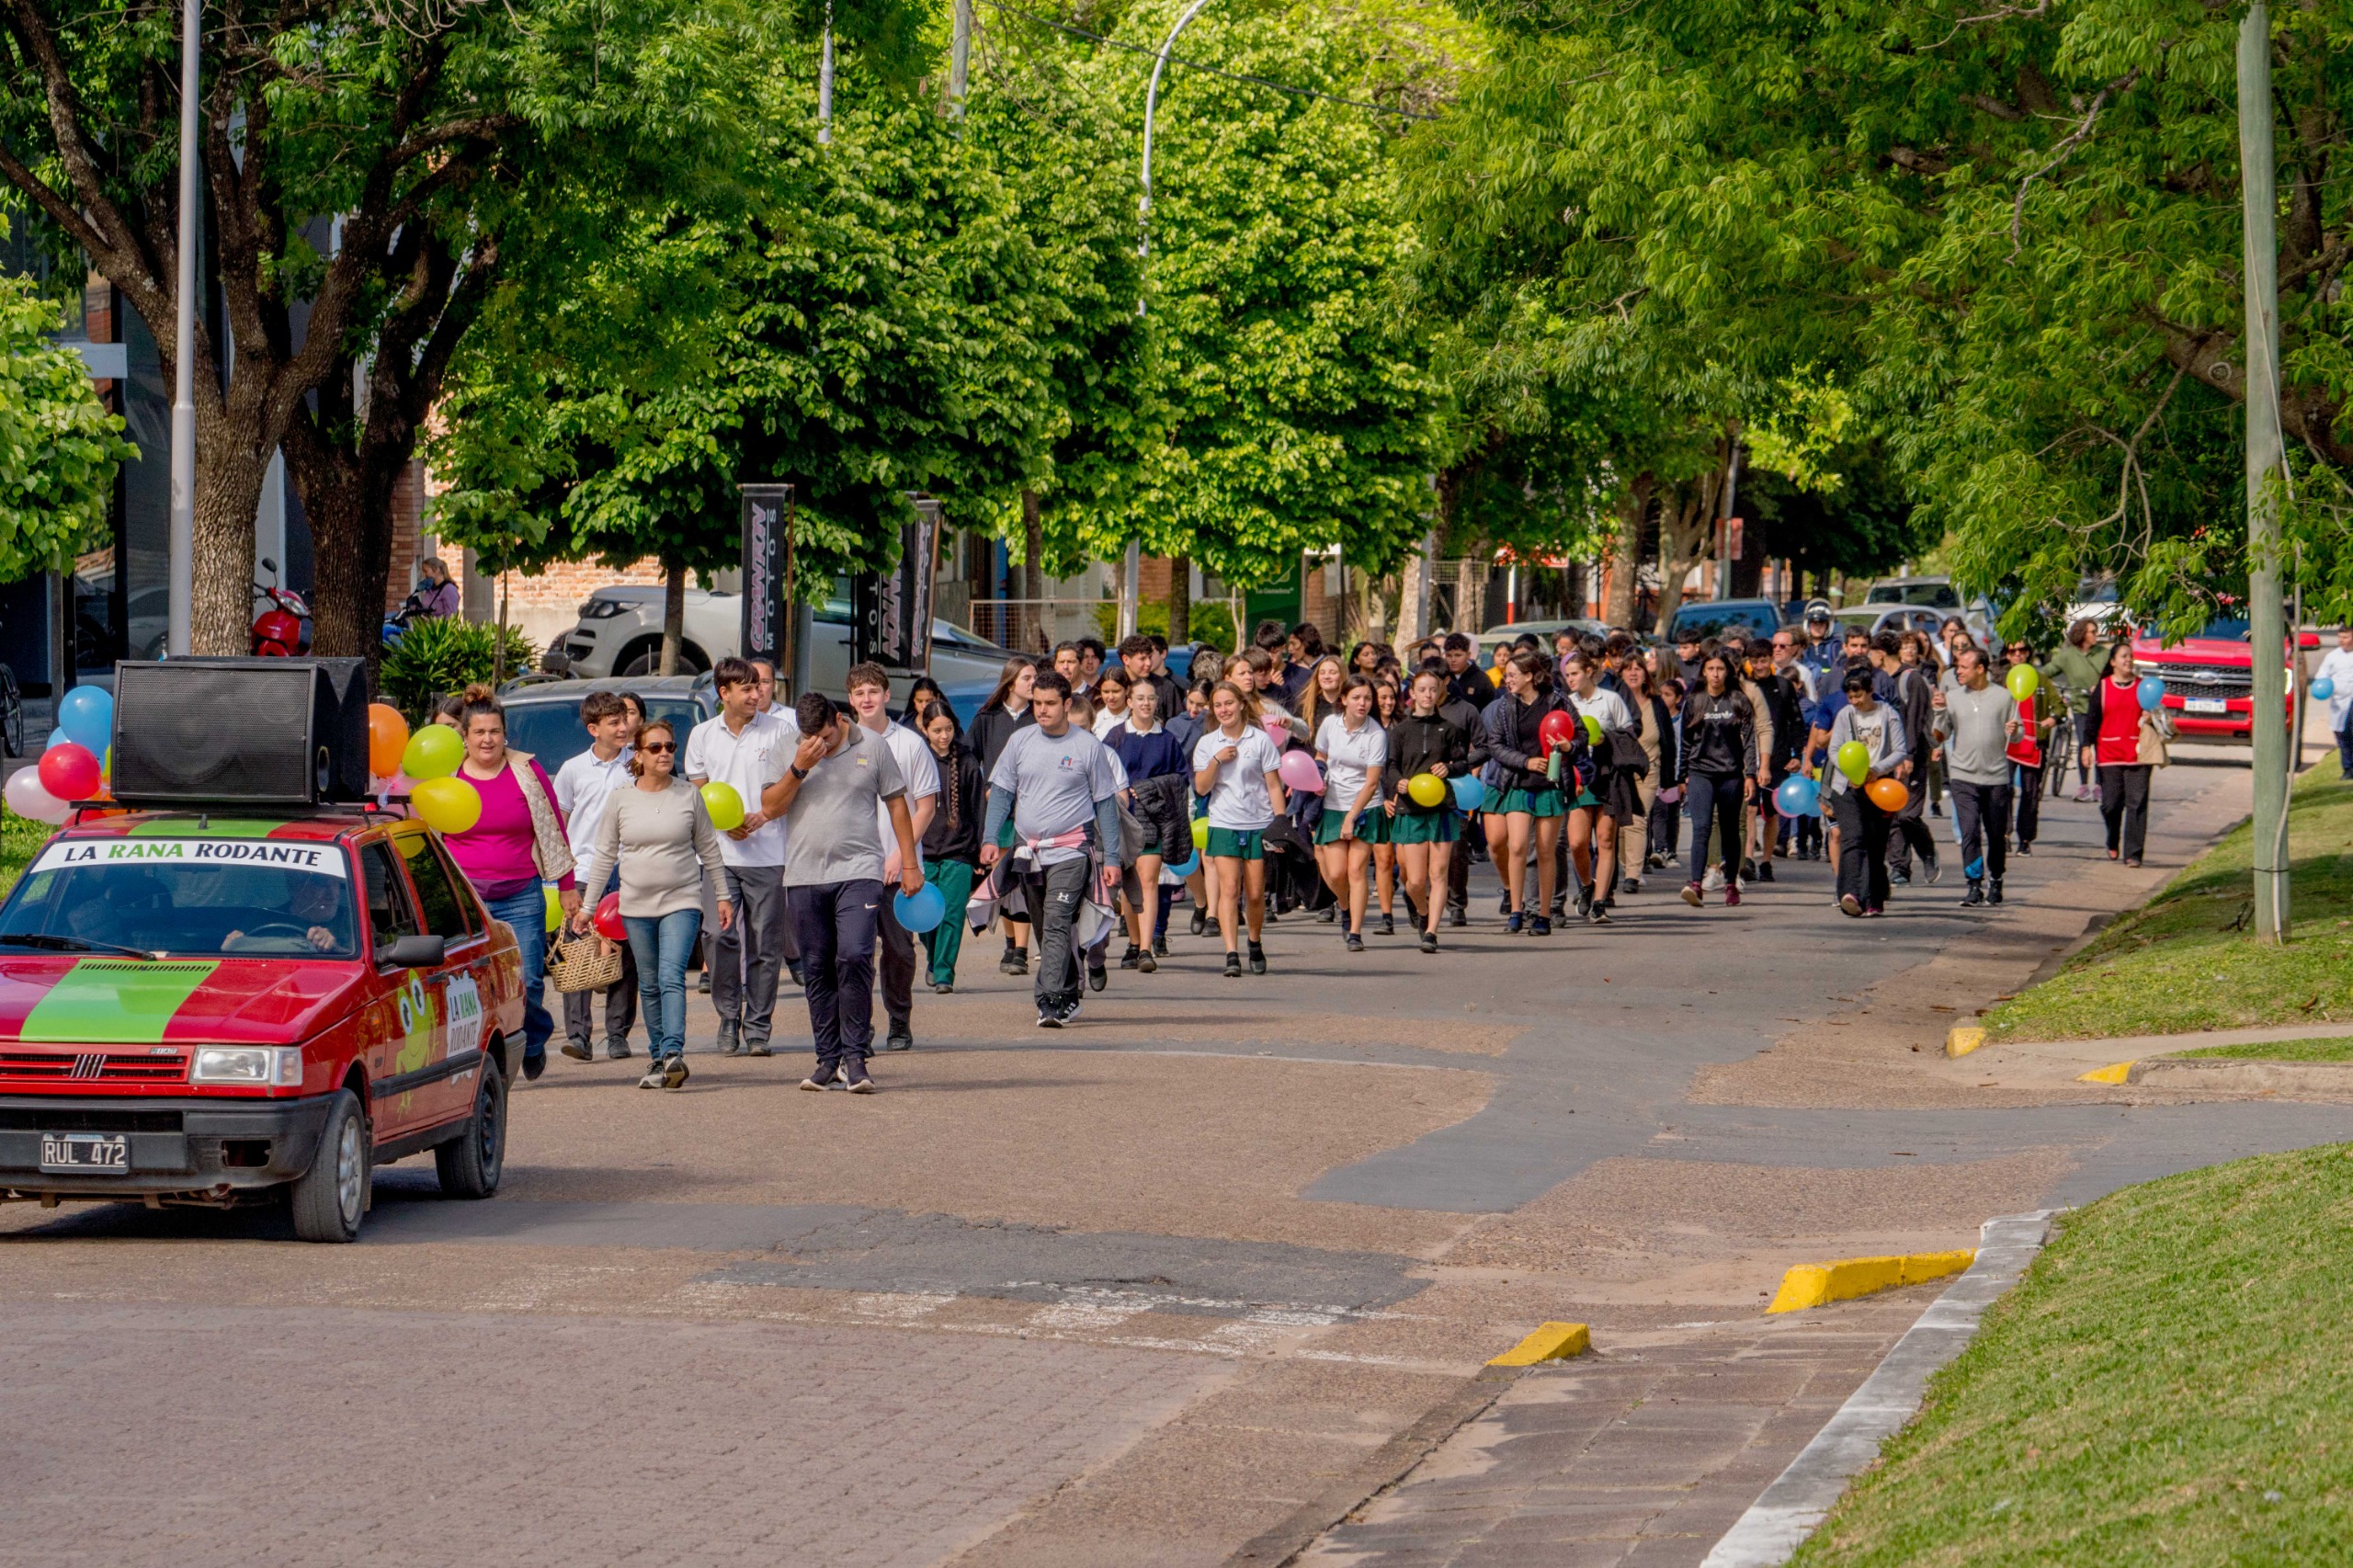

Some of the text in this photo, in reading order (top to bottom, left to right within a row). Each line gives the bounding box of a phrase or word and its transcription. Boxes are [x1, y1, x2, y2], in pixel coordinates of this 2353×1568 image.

[767, 508, 777, 650] MOTOS
[63, 843, 322, 867] LA RANA RODANTE
[449, 990, 478, 1022] LA RANA
[449, 1021, 478, 1053] RODANTE
[44, 1142, 126, 1165] RUL 472
